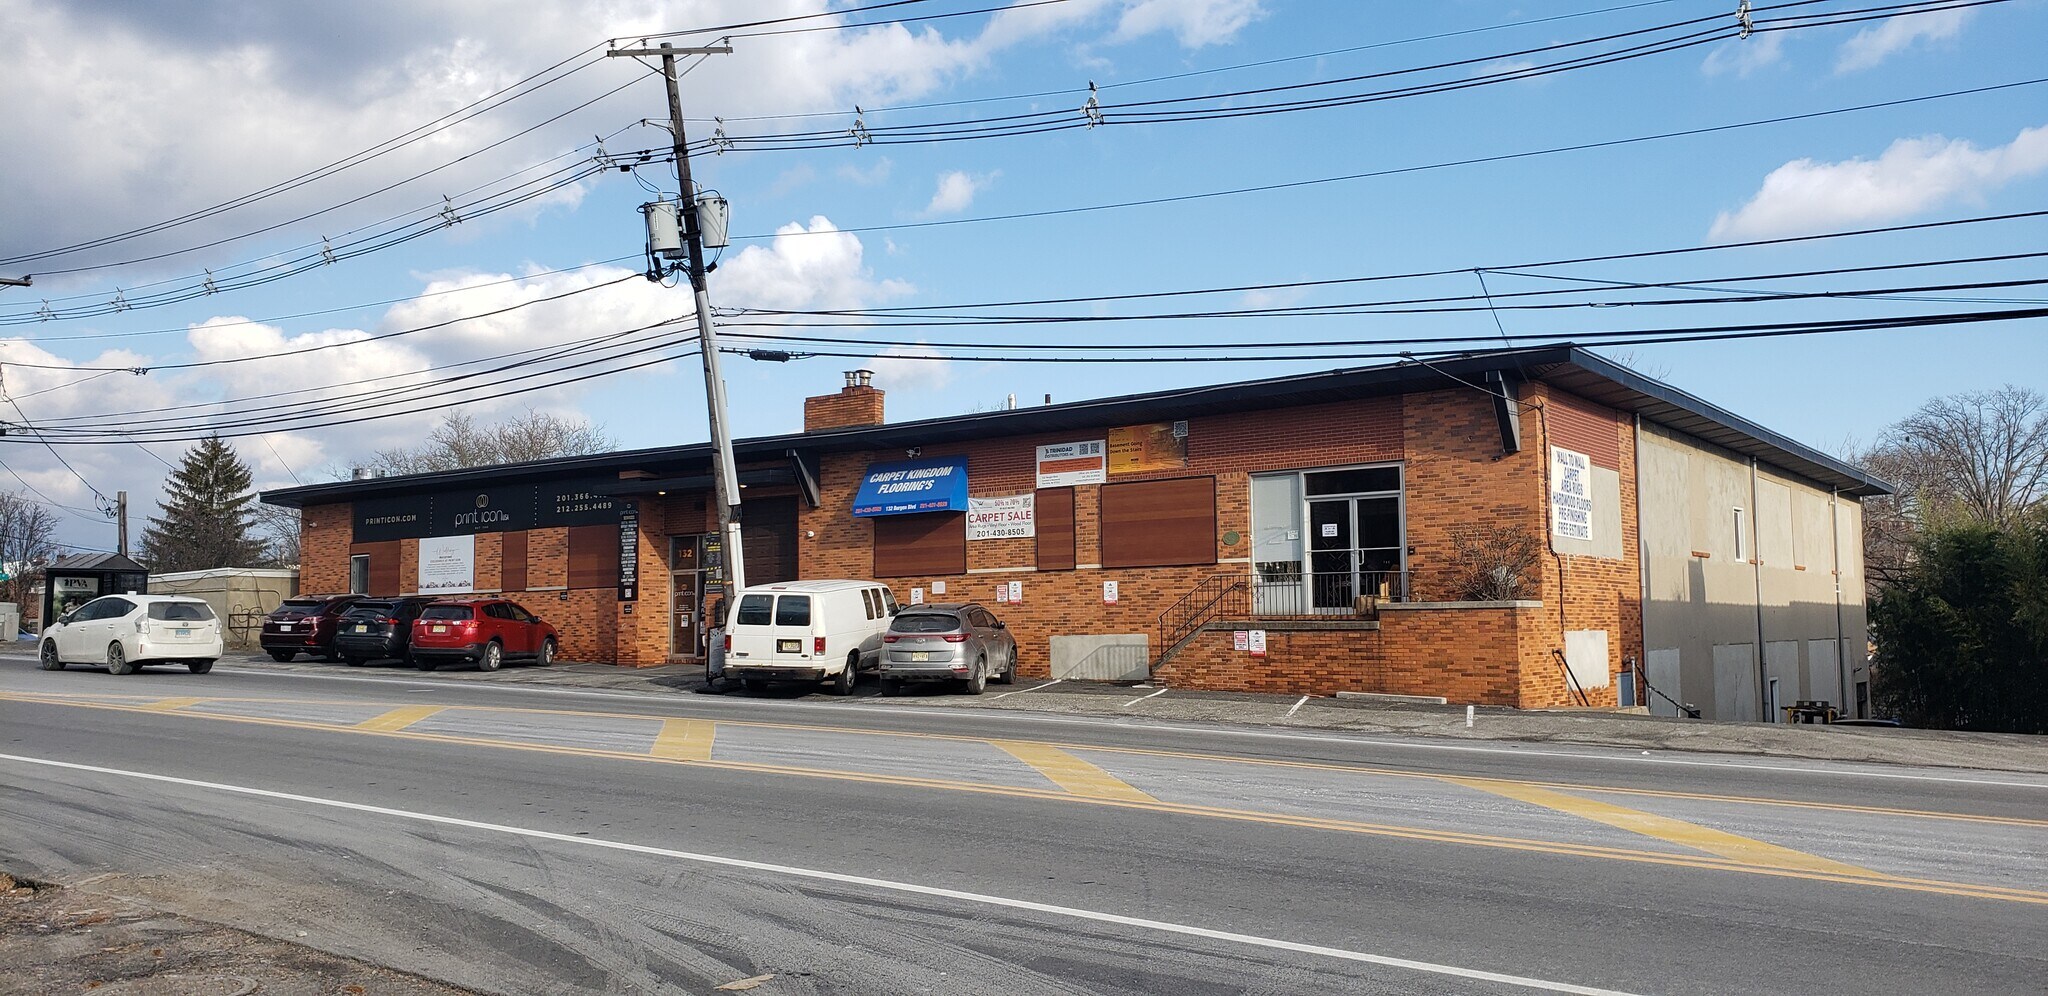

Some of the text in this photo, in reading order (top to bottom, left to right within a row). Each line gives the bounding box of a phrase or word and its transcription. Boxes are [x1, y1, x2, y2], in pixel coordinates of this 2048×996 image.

[1049, 446, 1073, 454] TRINIDAD
[1556, 450, 1585, 470] WALL TO WALL
[870, 466, 954, 483] CARPET KINGDOM
[1564, 466, 1579, 482] CARPET
[877, 479, 935, 494] FLOORING'S
[1561, 479, 1583, 496] AREA RUGS
[557, 502, 612, 513] 212.255.4489
[994, 499, 1005, 507] 50%
[1009, 498, 1020, 506] 70%
[1553, 491, 1592, 512] HARDWOOD FLOORS
[365, 514, 417, 525] PRINTICON.COM
[455, 508, 479, 528] print
[968, 510, 1032, 523] CARPET SALE
[976, 528, 1025, 538] 201-430-8505
[1557, 521, 1588, 539] FREE ESTIMATE
[678, 549, 693, 558] 132
